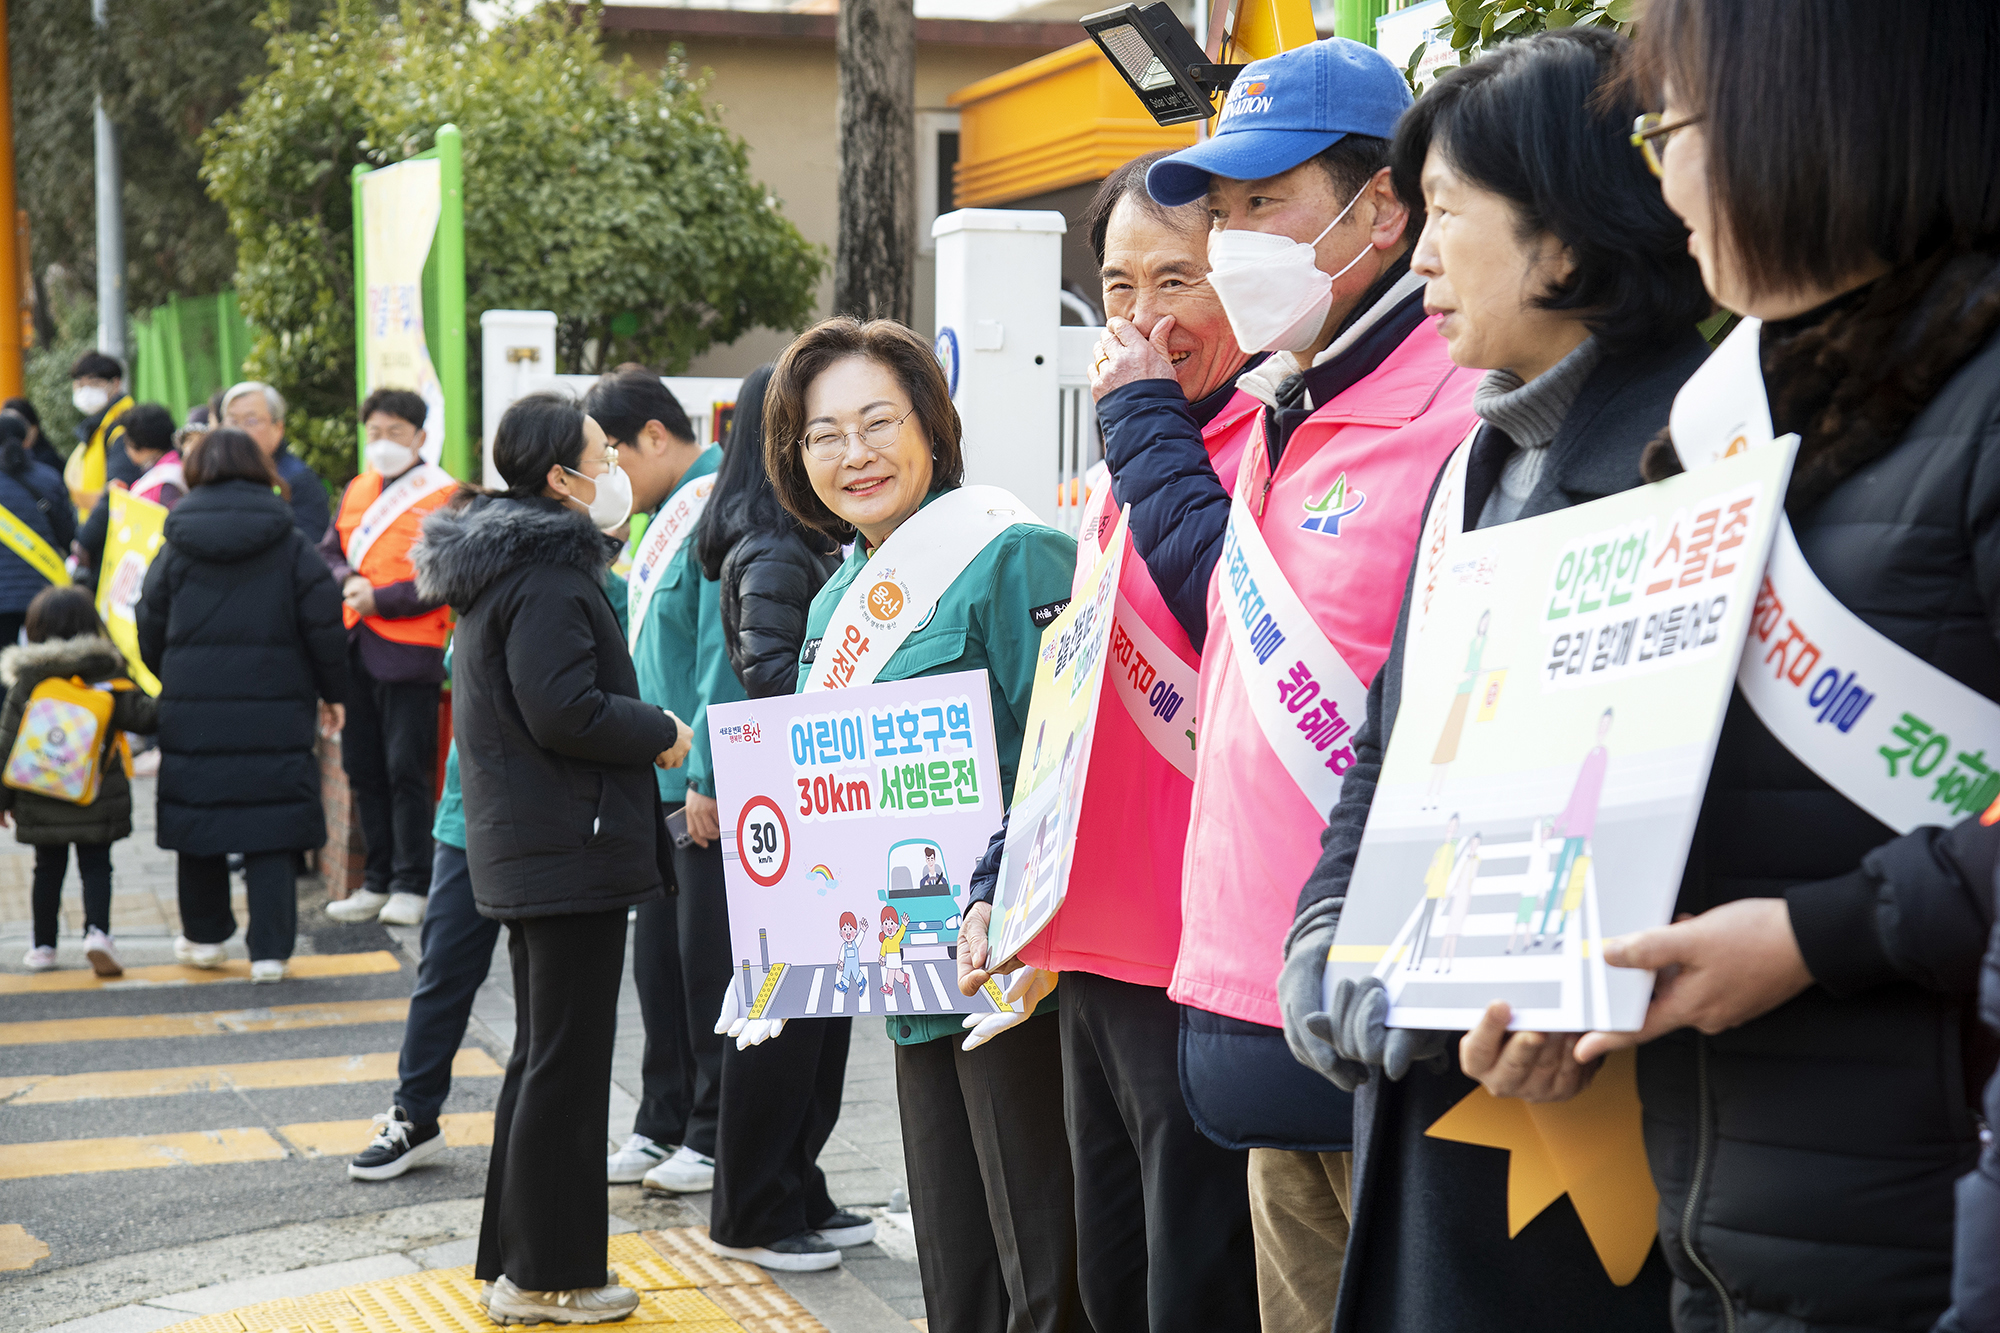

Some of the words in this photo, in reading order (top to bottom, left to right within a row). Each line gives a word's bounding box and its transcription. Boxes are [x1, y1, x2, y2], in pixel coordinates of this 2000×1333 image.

[1547, 530, 1650, 621] 안전한
[1645, 496, 1755, 597] 스쿨존
[871, 585, 901, 618] 용산
[1036, 607, 1052, 620] 서울
[1548, 628, 1594, 680] 우리
[1591, 617, 1639, 672] 함께
[1638, 595, 1728, 662] 만들어요
[719, 727, 732, 736] 새로운
[732, 725, 742, 735] 변화
[729, 734, 742, 743] 행복한
[742, 722, 761, 744] 용산
[790, 715, 866, 766] 어린이
[872, 702, 973, 758] 보호구역
[797, 773, 872, 816] 30km
[879, 757, 981, 811] 서행운전
[750, 821, 777, 854] 30
[758, 855, 773, 864] km/h
